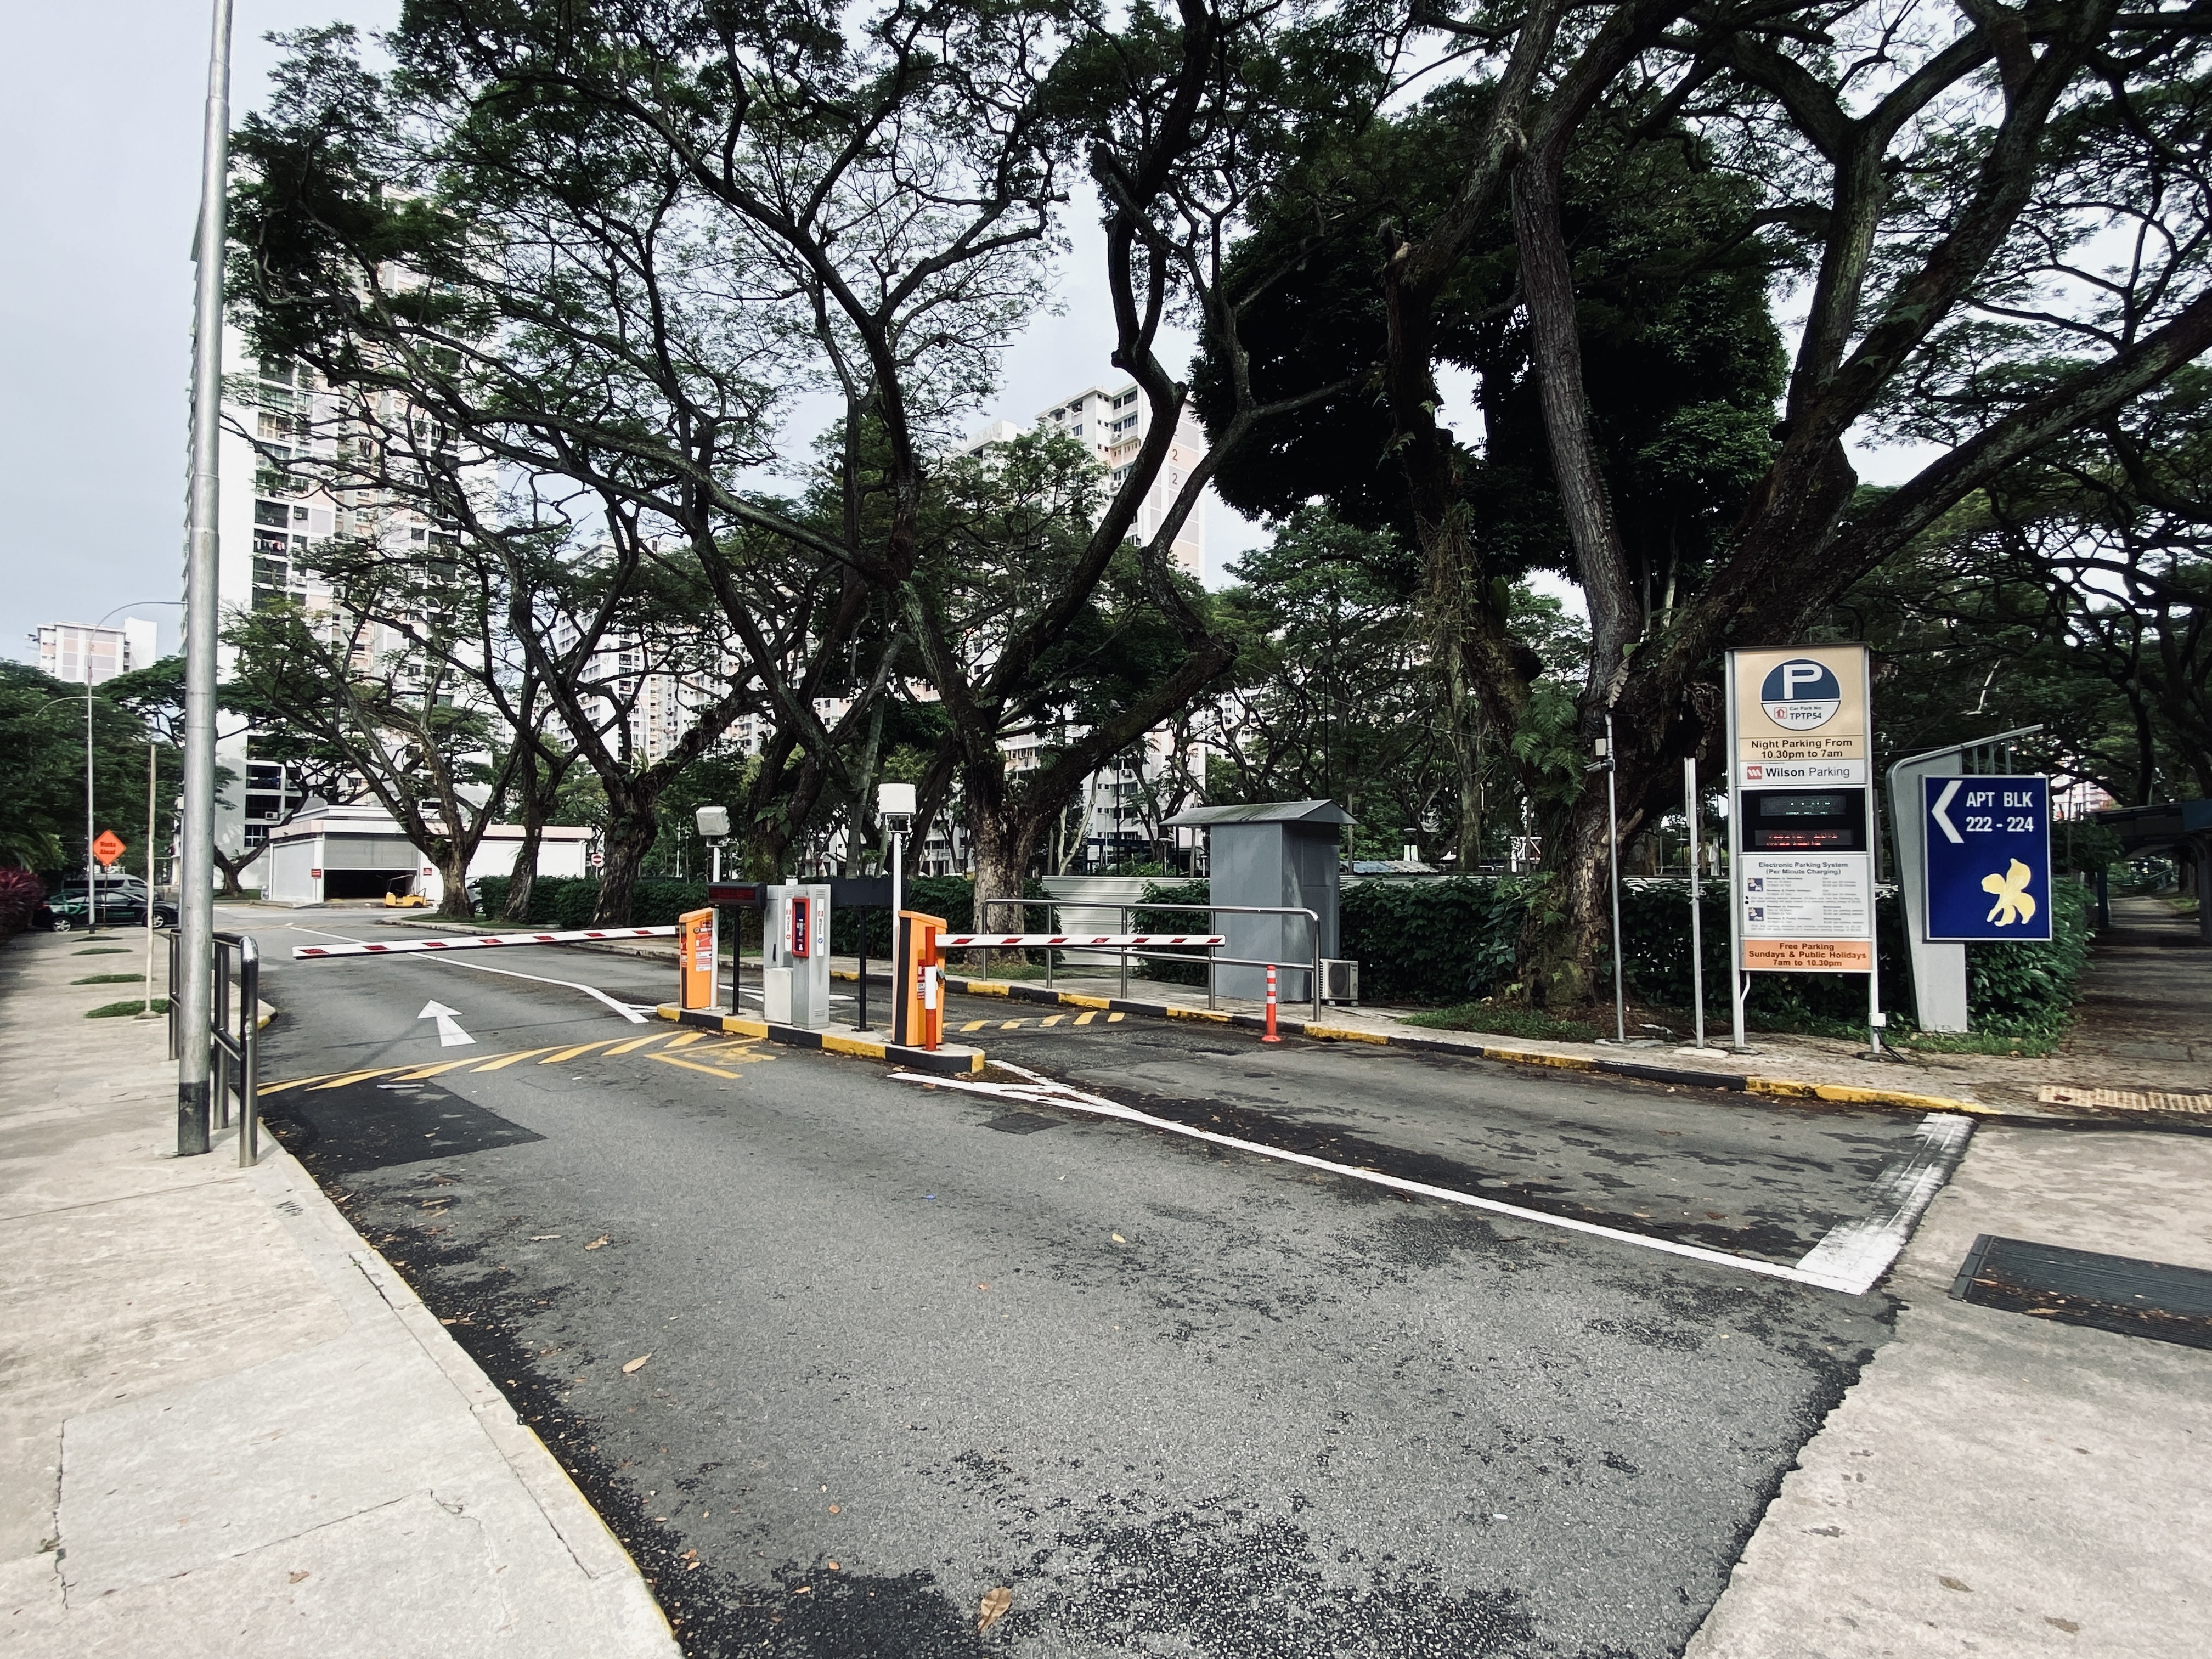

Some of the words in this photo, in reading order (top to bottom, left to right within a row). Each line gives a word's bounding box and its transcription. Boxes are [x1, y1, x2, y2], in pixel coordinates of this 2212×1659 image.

[1784, 664, 1823, 699] P
[1752, 740, 1779, 749] Night
[1782, 740, 1822, 749] Parking
[1762, 751, 1804, 760] 10.30pm
[1765, 768, 1805, 777] Wilson
[1809, 766, 1850, 778] Parking
[1966, 792, 1995, 807] APT
[2004, 792, 2033, 807] BLK
[1966, 816, 1993, 832] 222
[2007, 816, 2034, 832] 224
[1802, 943, 1835, 951] Parking
[1749, 951, 1785, 959] Sundays
